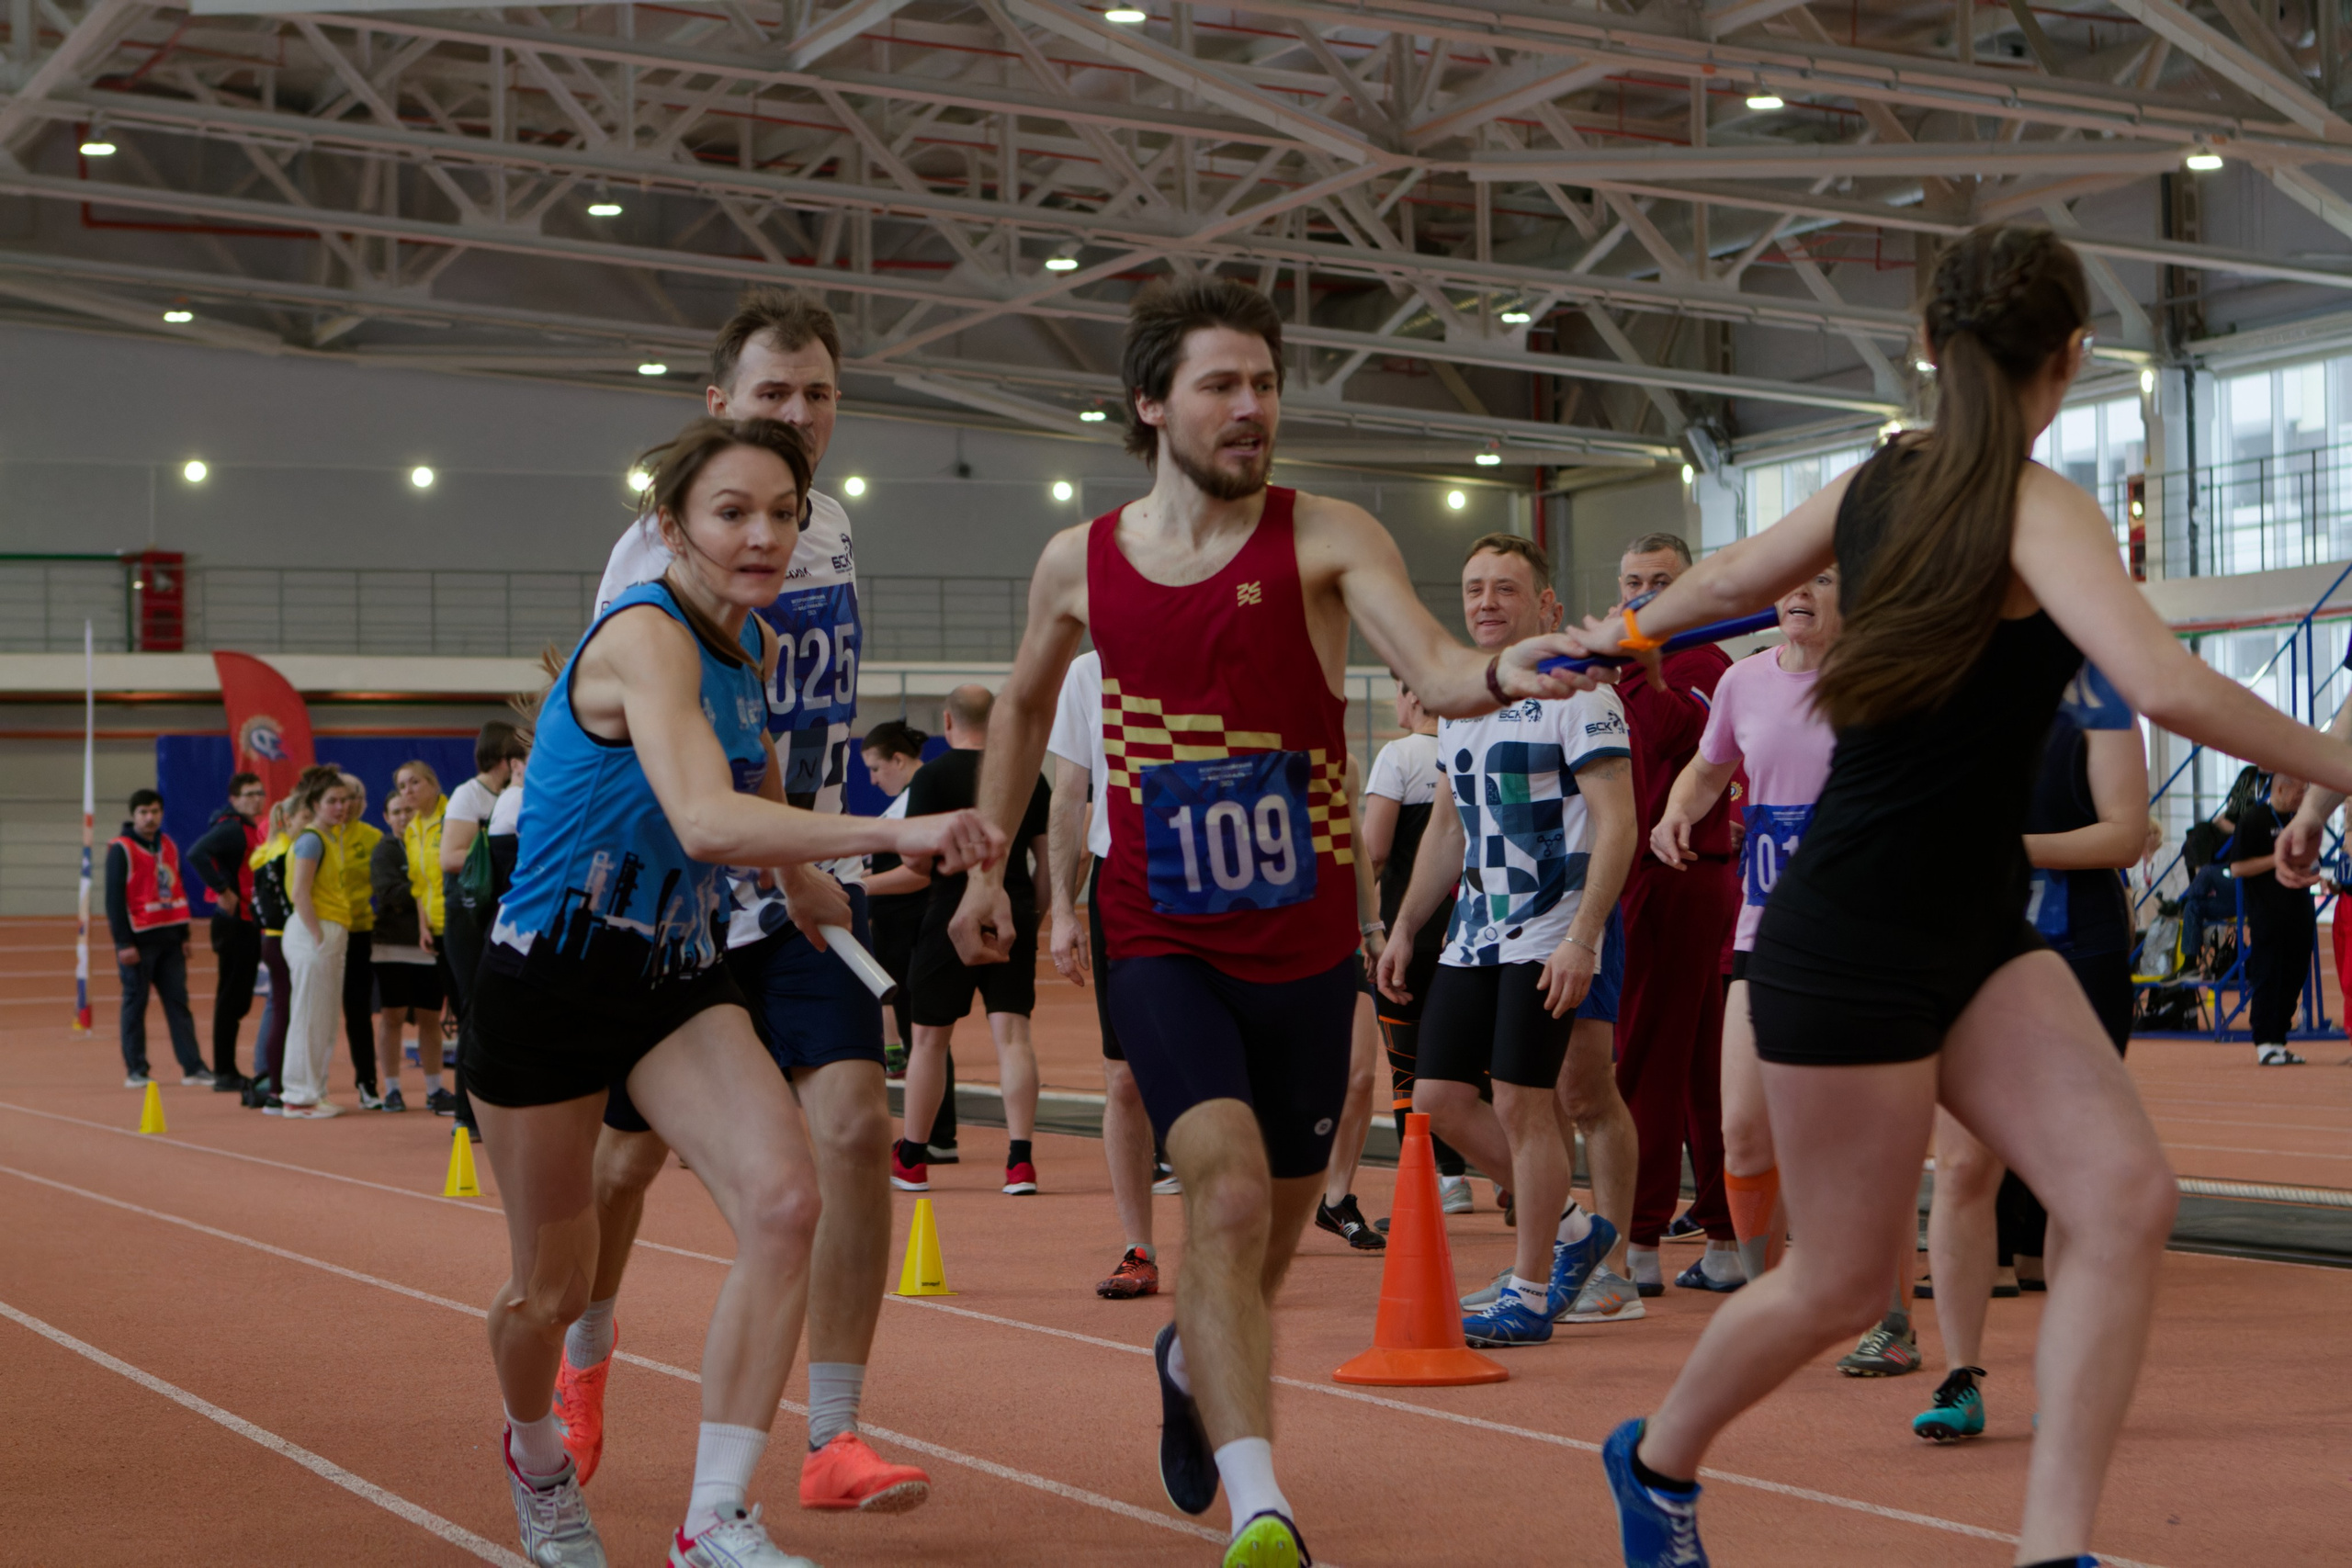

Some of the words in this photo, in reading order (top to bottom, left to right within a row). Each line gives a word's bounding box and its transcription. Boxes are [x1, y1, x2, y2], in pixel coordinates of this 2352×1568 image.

[767, 623, 854, 715] 025
[1498, 709, 1521, 719] БСК
[1585, 722, 1612, 734] БСК
[1169, 794, 1297, 893] 109
